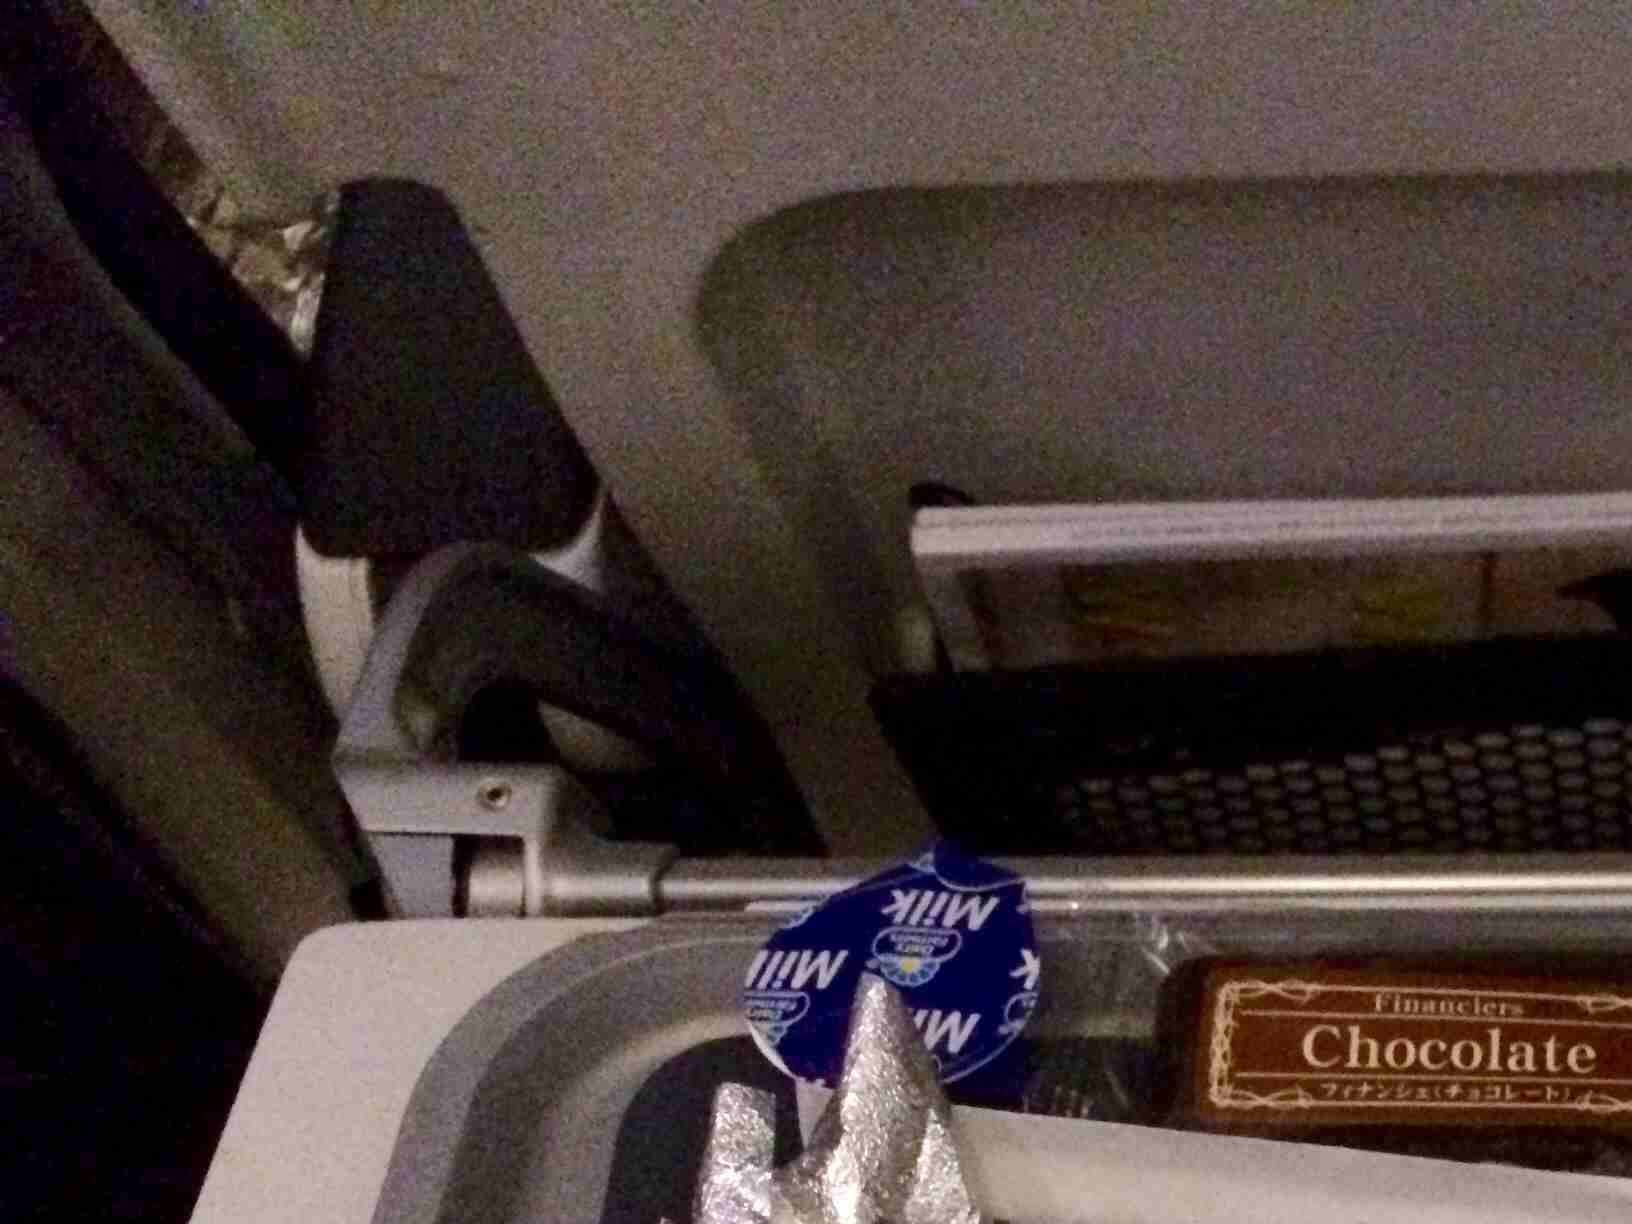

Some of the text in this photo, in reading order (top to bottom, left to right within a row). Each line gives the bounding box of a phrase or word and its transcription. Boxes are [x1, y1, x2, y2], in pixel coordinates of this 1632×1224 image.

[882, 889, 999, 931] Milk
[1374, 992, 1525, 1018] Financiers
[1303, 1023, 1596, 1074] Chocolate
